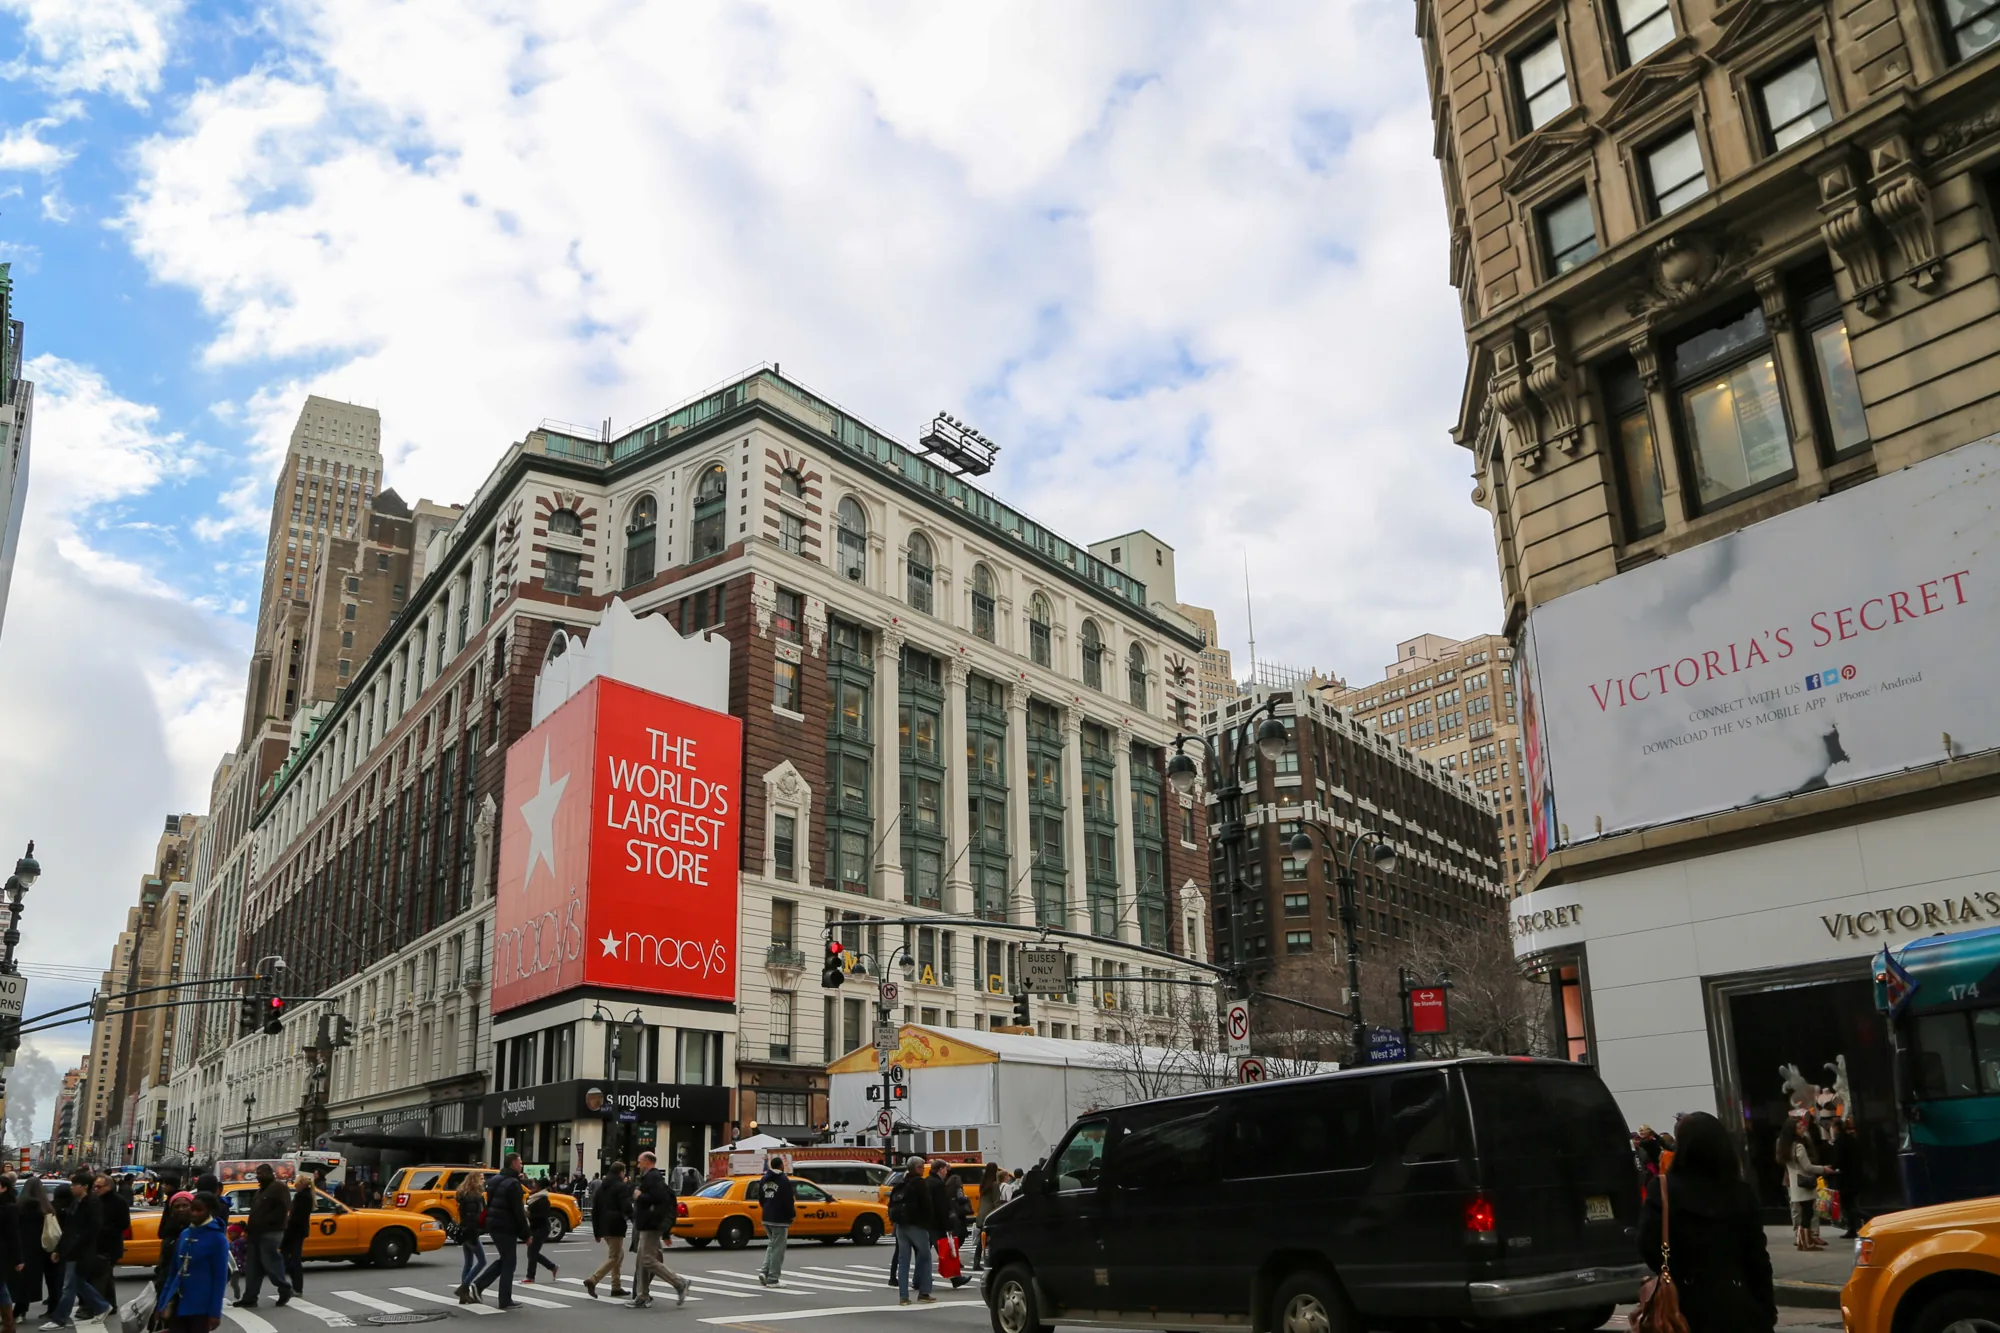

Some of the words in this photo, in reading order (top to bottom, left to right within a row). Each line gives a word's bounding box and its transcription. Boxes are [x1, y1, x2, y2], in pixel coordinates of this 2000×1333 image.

[1589, 627, 1794, 712] VICTORIA'S
[1810, 570, 1971, 648] SECRET
[1642, 729, 1708, 756] DOWNLOAD
[1711, 722, 1734, 737] THE
[1737, 717, 1752, 730] VS
[1756, 704, 1801, 726] MOBILE
[1805, 696, 1827, 713] APP
[1880, 671, 1923, 693] Android
[1689, 698, 1744, 723] CONNECT
[1747, 688, 1781, 706] WITH
[1784, 682, 1801, 696] US
[645, 727, 697, 771] THE
[608, 755, 729, 815] WORLD'S
[607, 794, 726, 851] LARGEST
[625, 838, 709, 887] STORE
[1517, 904, 1582, 935] SECRET
[1819, 891, 2000, 938] VICTORIA'S
[1027, 954, 1057, 963] BUSES
[1031, 966, 1054, 975] ONLY
[1948, 982, 1980, 1000] 174
[1371, 1034, 1388, 1043] Sixth
[1371, 1050, 1389, 1060] West
[507, 1096, 527, 1117] sunglass
[526, 1095, 535, 1111] hut
[661, 1091, 681, 1109] hut
